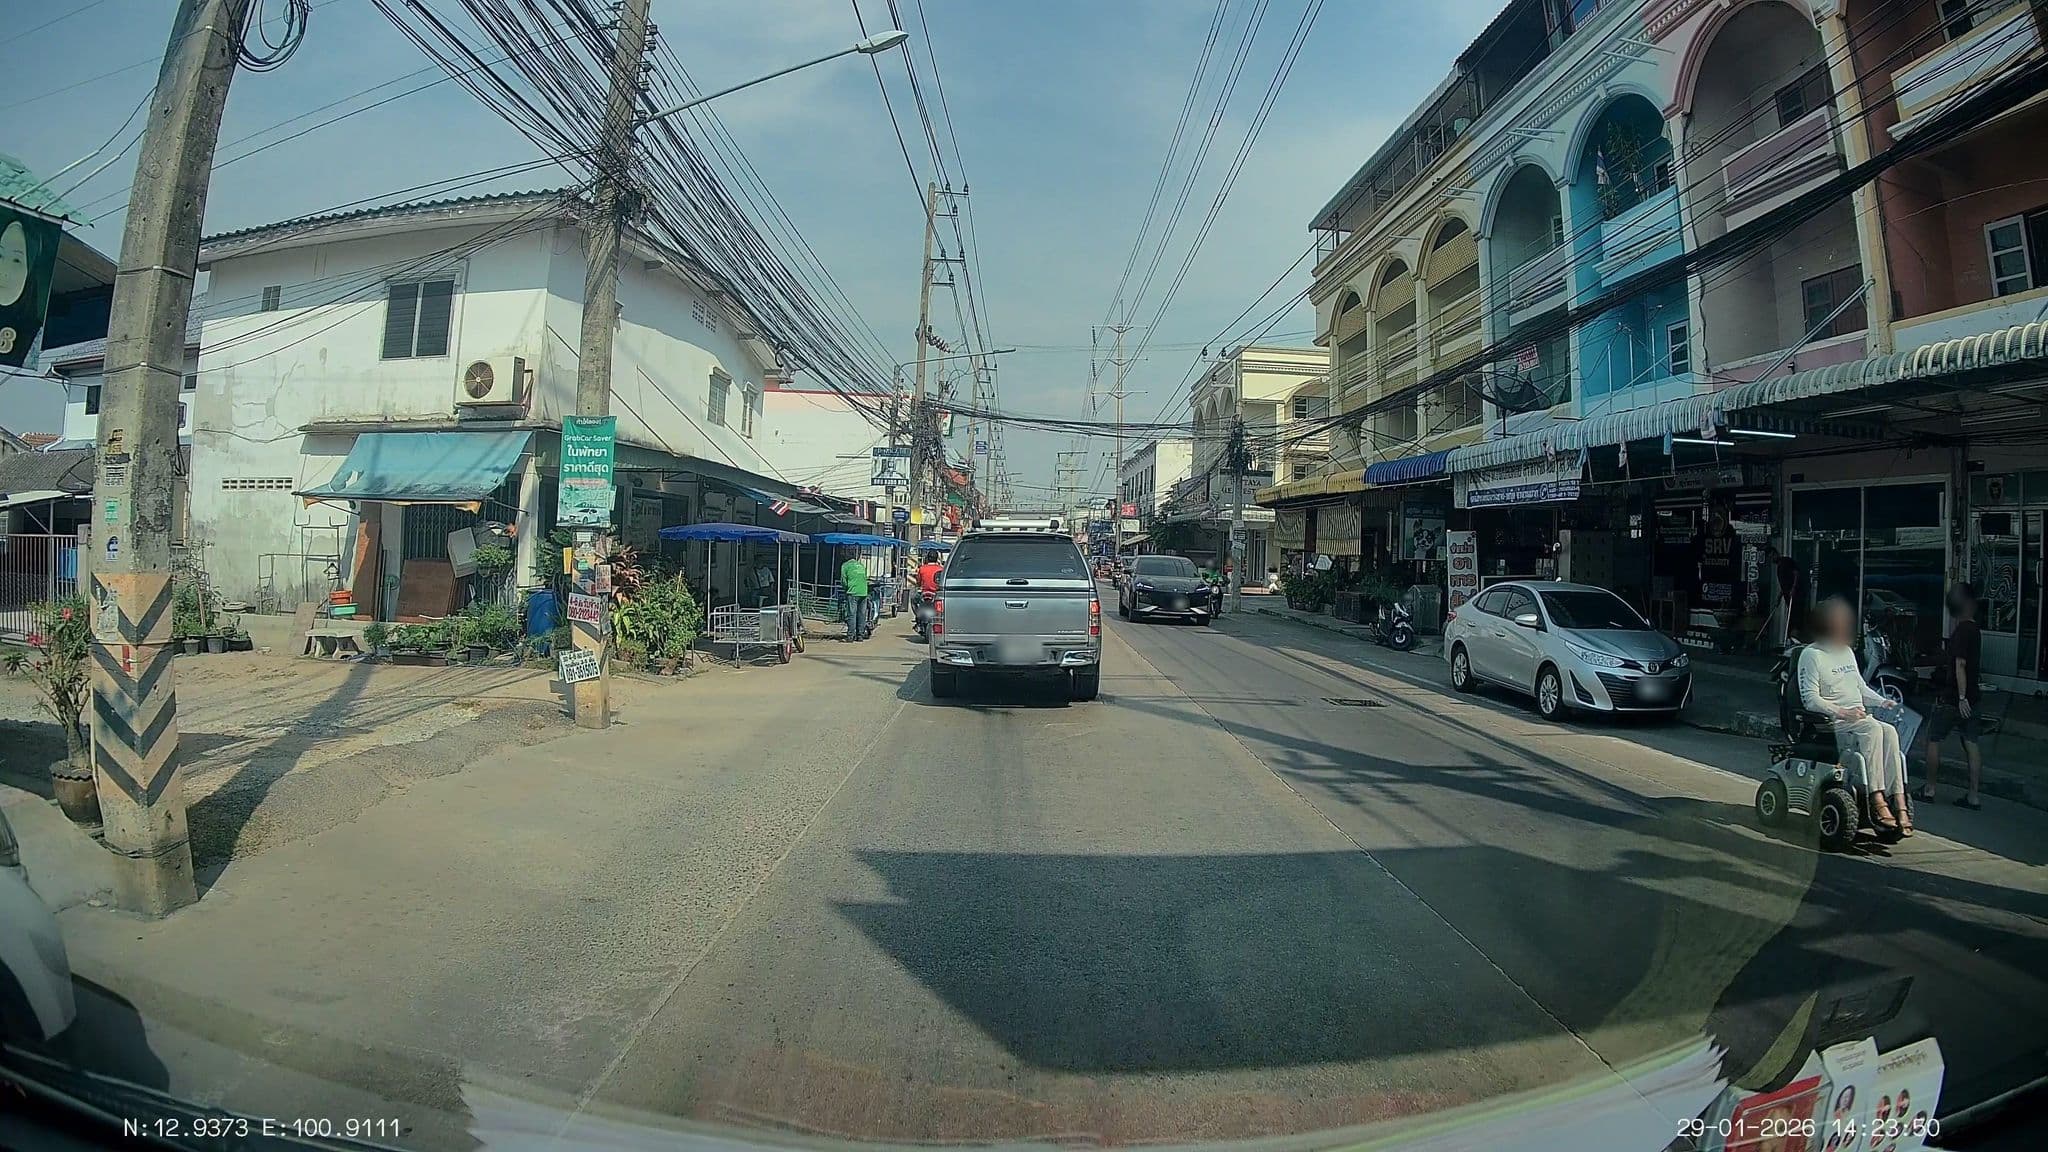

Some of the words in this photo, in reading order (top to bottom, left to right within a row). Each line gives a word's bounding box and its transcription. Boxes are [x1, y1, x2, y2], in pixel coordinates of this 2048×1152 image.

[564, 434, 592, 442] GrabCar
[593, 434, 612, 442] Saver
[567, 444, 608, 457] ในพัทยา
[563, 461, 609, 476] ราคาดีสุด
[1705, 538, 1732, 555] SRV
